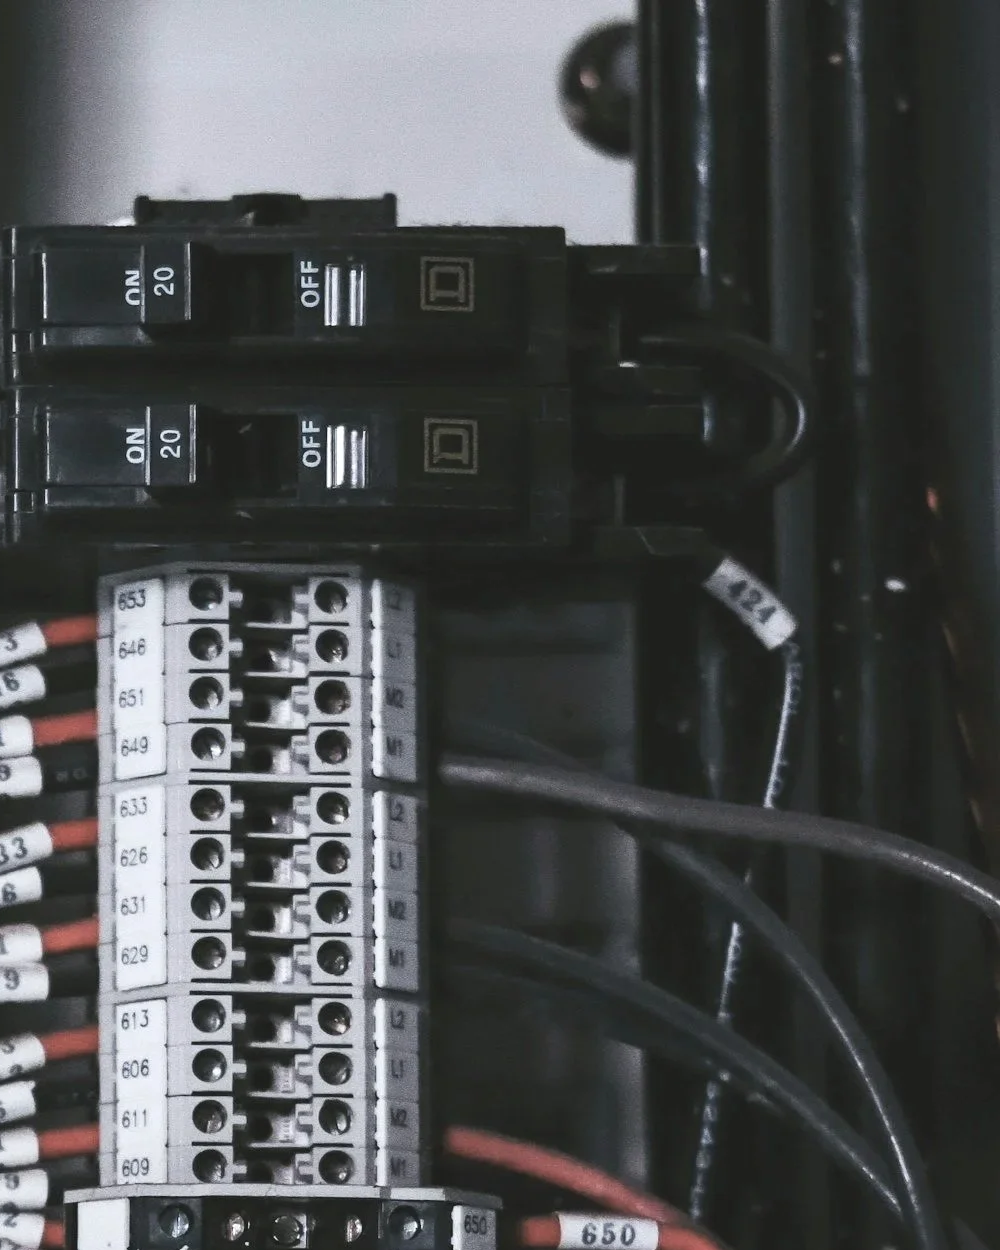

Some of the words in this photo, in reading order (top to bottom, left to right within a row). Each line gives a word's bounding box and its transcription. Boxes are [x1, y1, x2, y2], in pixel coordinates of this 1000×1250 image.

[154, 267, 174, 296] 20
[301, 260, 319, 308] OFF
[126, 428, 145, 464] ON
[160, 430, 180, 459] 20
[302, 421, 321, 468] OFF
[119, 689, 145, 708] 651
[121, 736, 149, 757] 649
[120, 797, 147, 817] 633
[120, 846, 147, 867] 626
[120, 896, 145, 916] 631
[121, 945, 148, 965] 629
[121, 1009, 149, 1030] 613
[122, 1059, 149, 1077] 606
[122, 1109, 147, 1128] 611
[122, 1158, 149, 1177] 609
[464, 1215, 487, 1236] 650
[581, 1222, 636, 1246] 650
